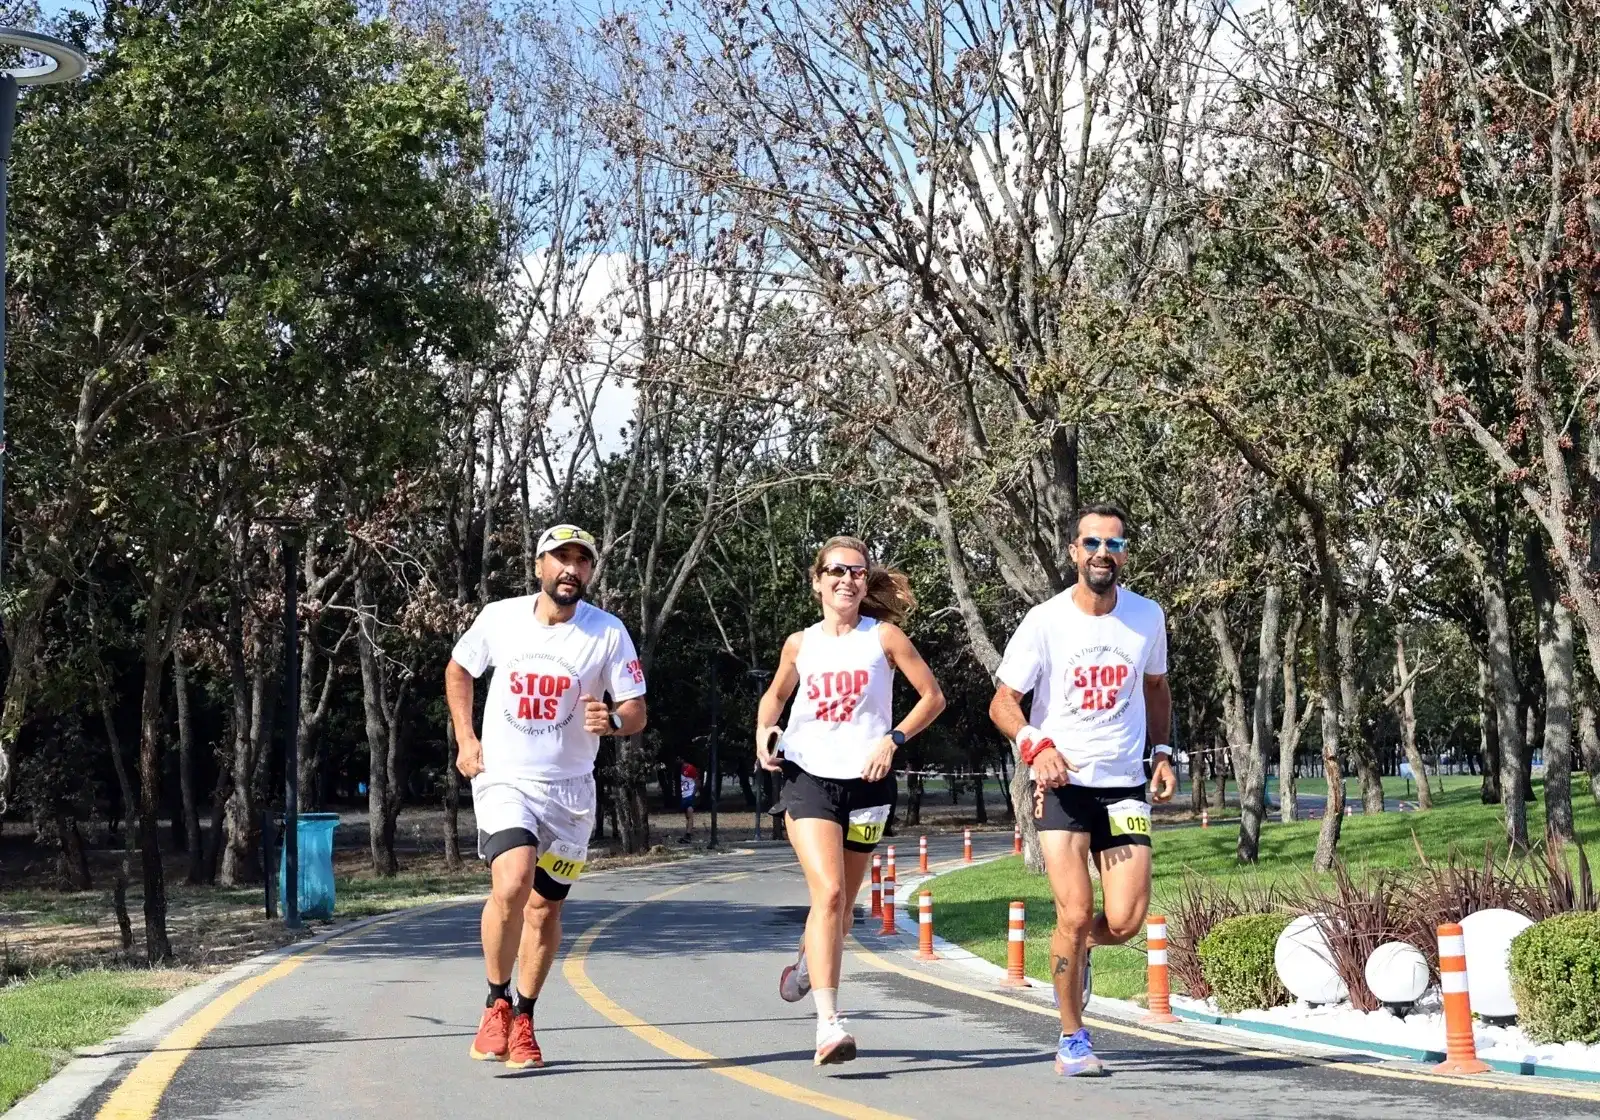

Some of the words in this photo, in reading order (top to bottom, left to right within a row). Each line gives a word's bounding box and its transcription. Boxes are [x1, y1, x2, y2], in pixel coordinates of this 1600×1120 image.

[510, 671, 571, 697] STOP
[807, 670, 869, 699] STOP
[1074, 664, 1128, 688] STOP
[517, 697, 559, 720] ALS
[816, 697, 856, 722] ALS
[1081, 688, 1119, 711] ALS
[1127, 817, 1147, 832] 013
[552, 860, 575, 876] 011
